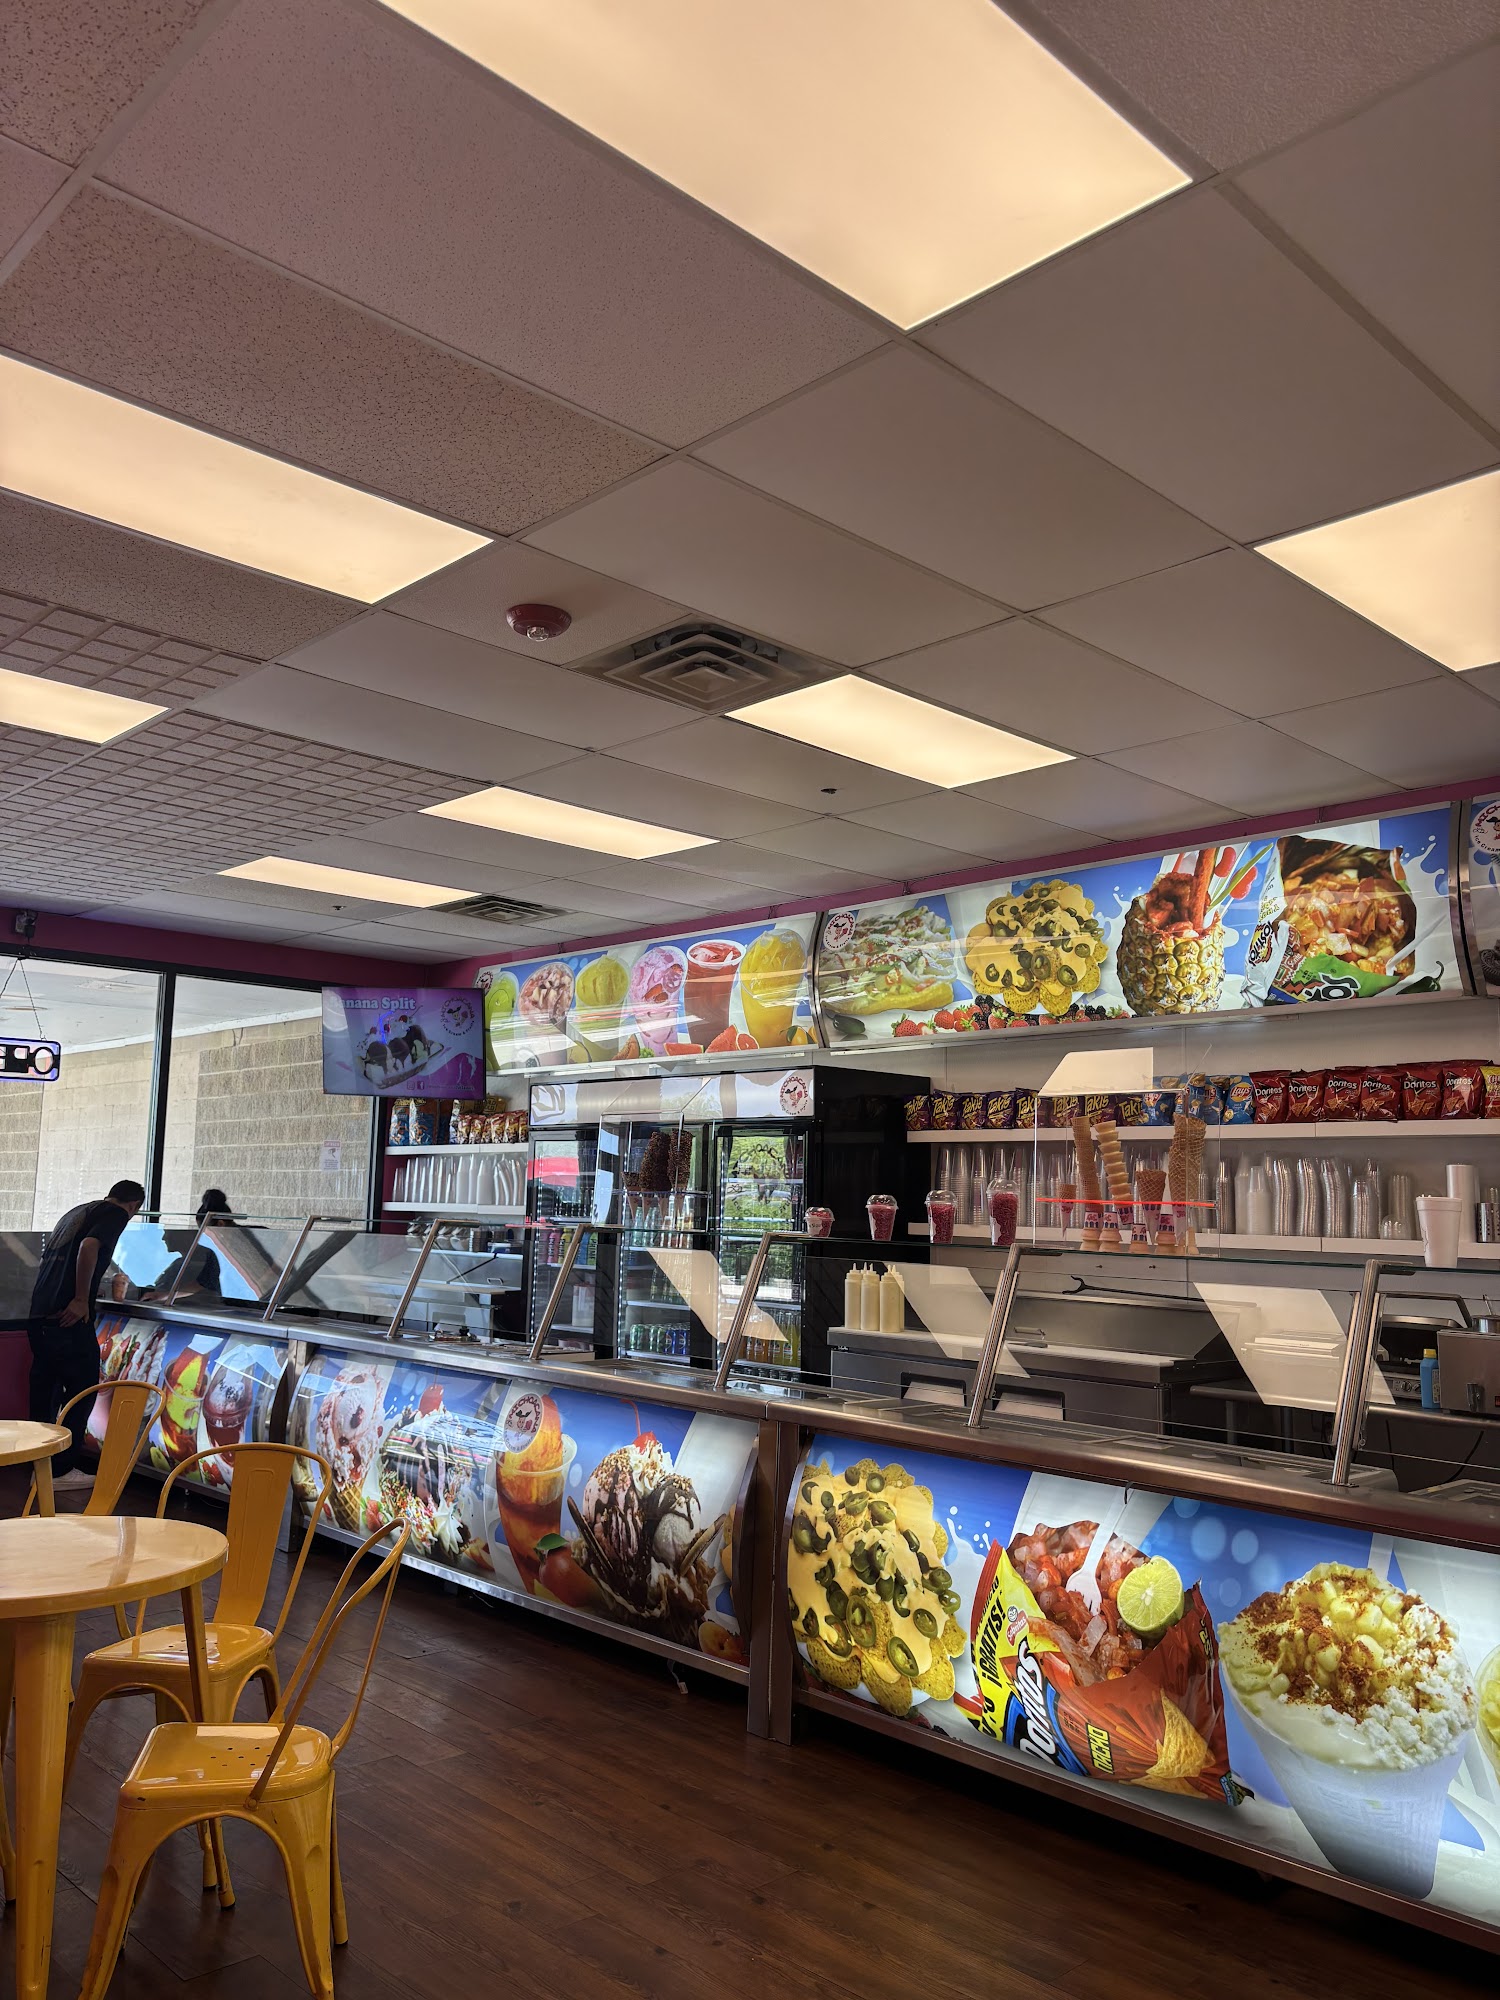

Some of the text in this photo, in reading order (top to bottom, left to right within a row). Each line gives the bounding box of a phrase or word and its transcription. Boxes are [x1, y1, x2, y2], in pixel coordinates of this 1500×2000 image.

[381, 996, 416, 1011] Split
[1328, 1080, 1358, 1090] Doritos
[1362, 1080, 1392, 1091] Doritos
[1404, 1081, 1437, 1089] Doritos
[1445, 1077, 1473, 1086] Doritos
[1255, 1087, 1283, 1097] Doritos
[1288, 1085, 1317, 1093] Doritos
[933, 1097, 956, 1116] Takis
[962, 1097, 983, 1117] Takis
[988, 1096, 1011, 1117] Takis
[978, 1597, 1007, 1689] ¡GRATIS!
[1016, 1639, 1057, 1765] Doritos
